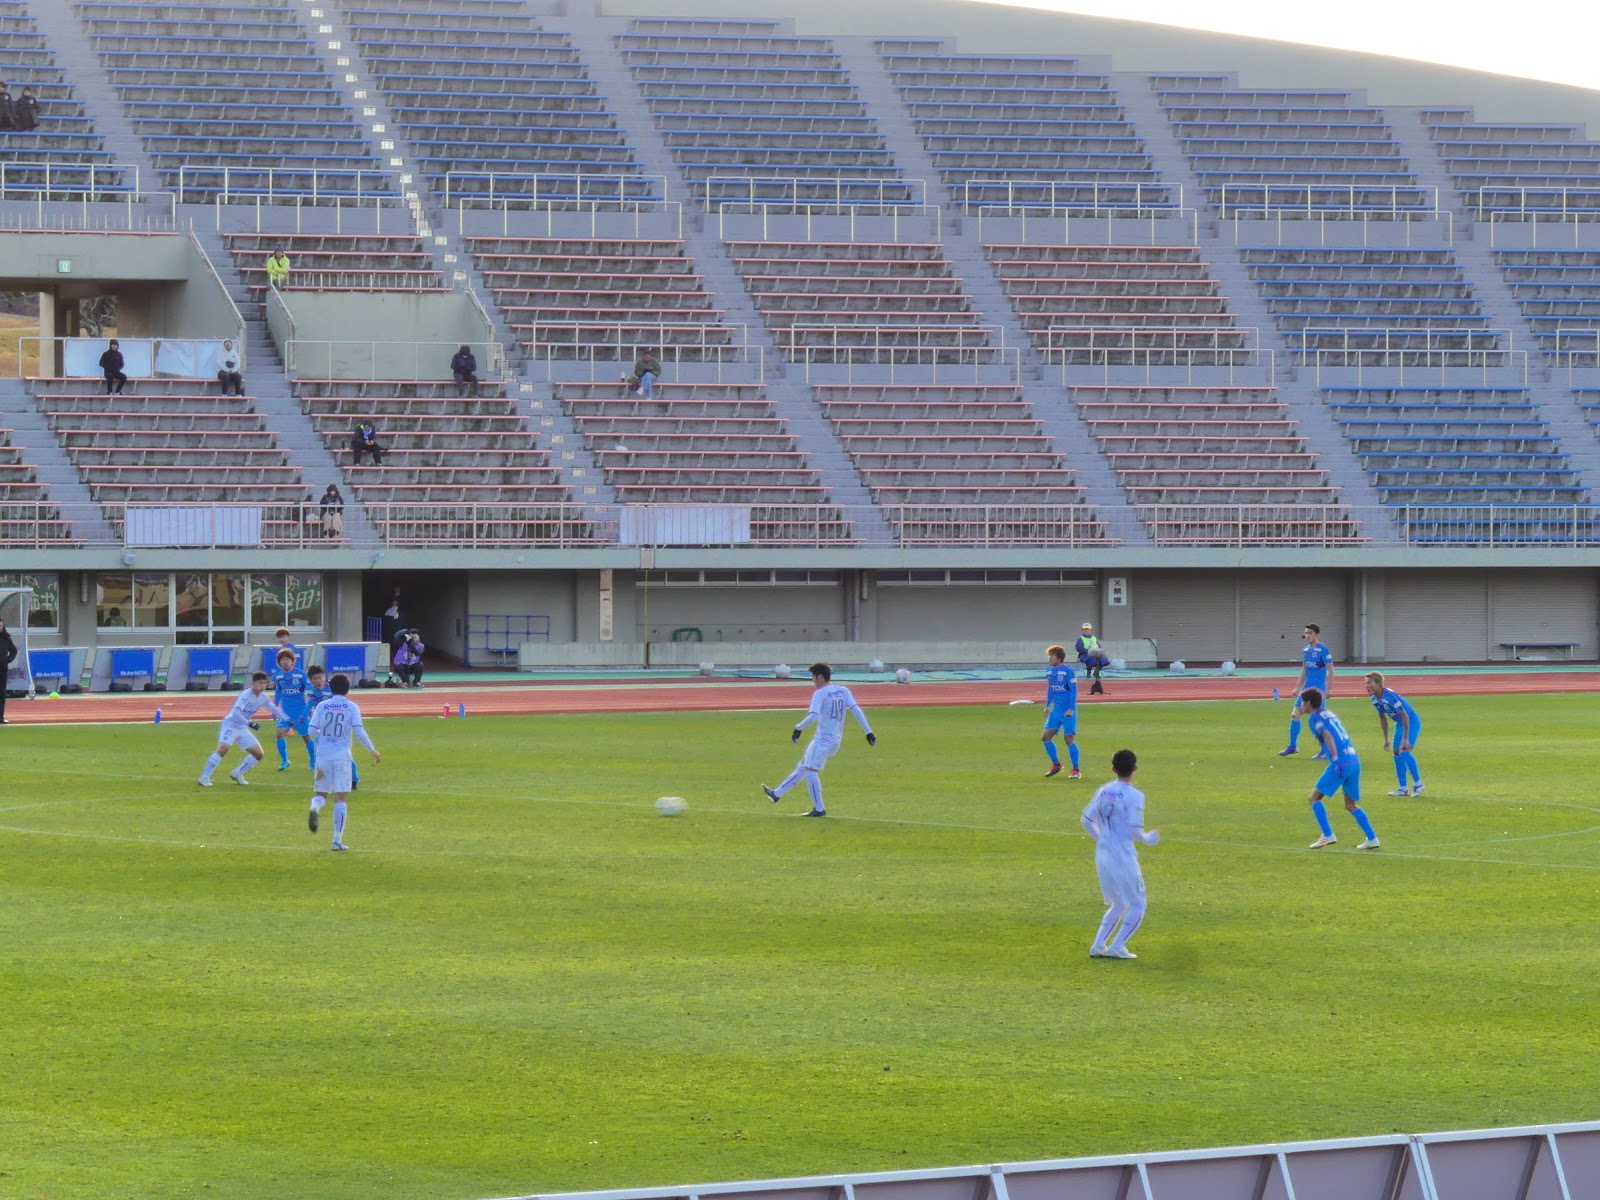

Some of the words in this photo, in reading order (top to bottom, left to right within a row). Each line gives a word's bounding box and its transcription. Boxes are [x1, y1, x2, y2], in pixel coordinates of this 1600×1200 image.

[284, 687, 301, 695] TDK
[323, 703, 348, 711] ROHTO
[322, 711, 345, 738] 26
